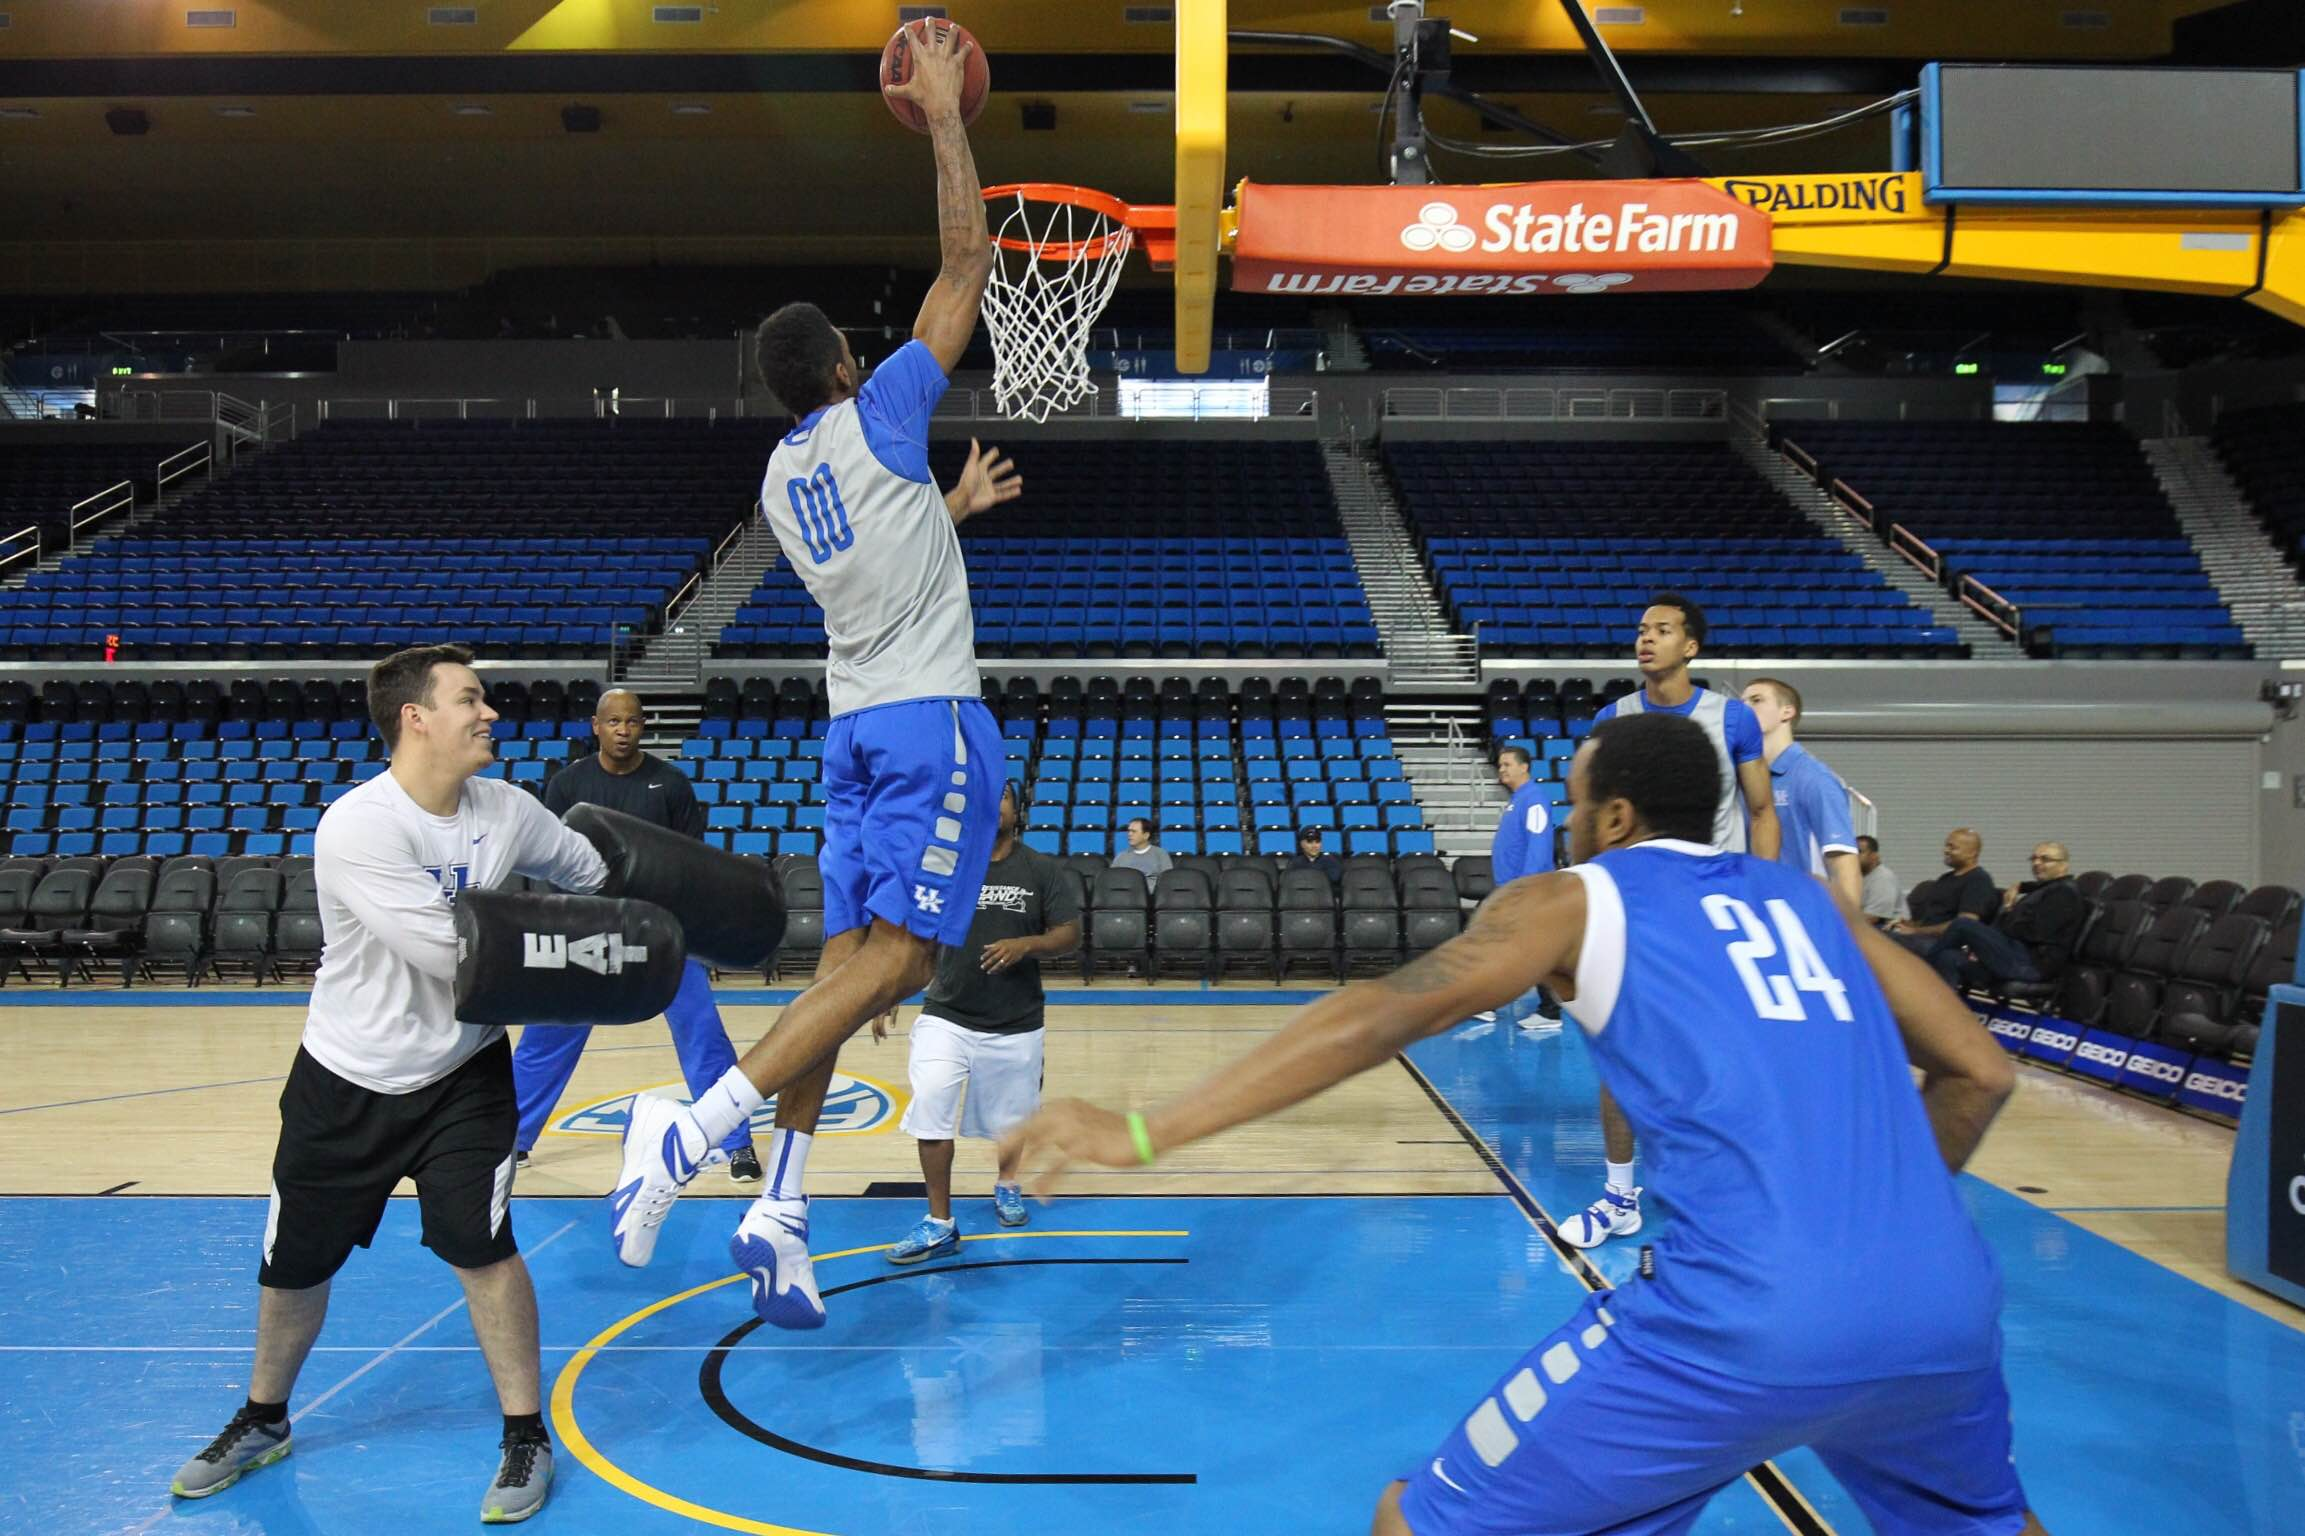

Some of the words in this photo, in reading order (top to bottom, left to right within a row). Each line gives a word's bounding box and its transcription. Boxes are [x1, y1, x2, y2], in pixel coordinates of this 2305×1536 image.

[787, 463, 854, 564] 00
[913, 884, 944, 914] UK
[523, 932, 648, 976] EAT
[1700, 894, 1854, 1022] 24
[1988, 1017, 2031, 1040] GEICO
[2030, 1028, 2078, 1052] GEICO
[2076, 1041, 2127, 1068] GEICO
[2126, 1054, 2184, 1083] GEICO
